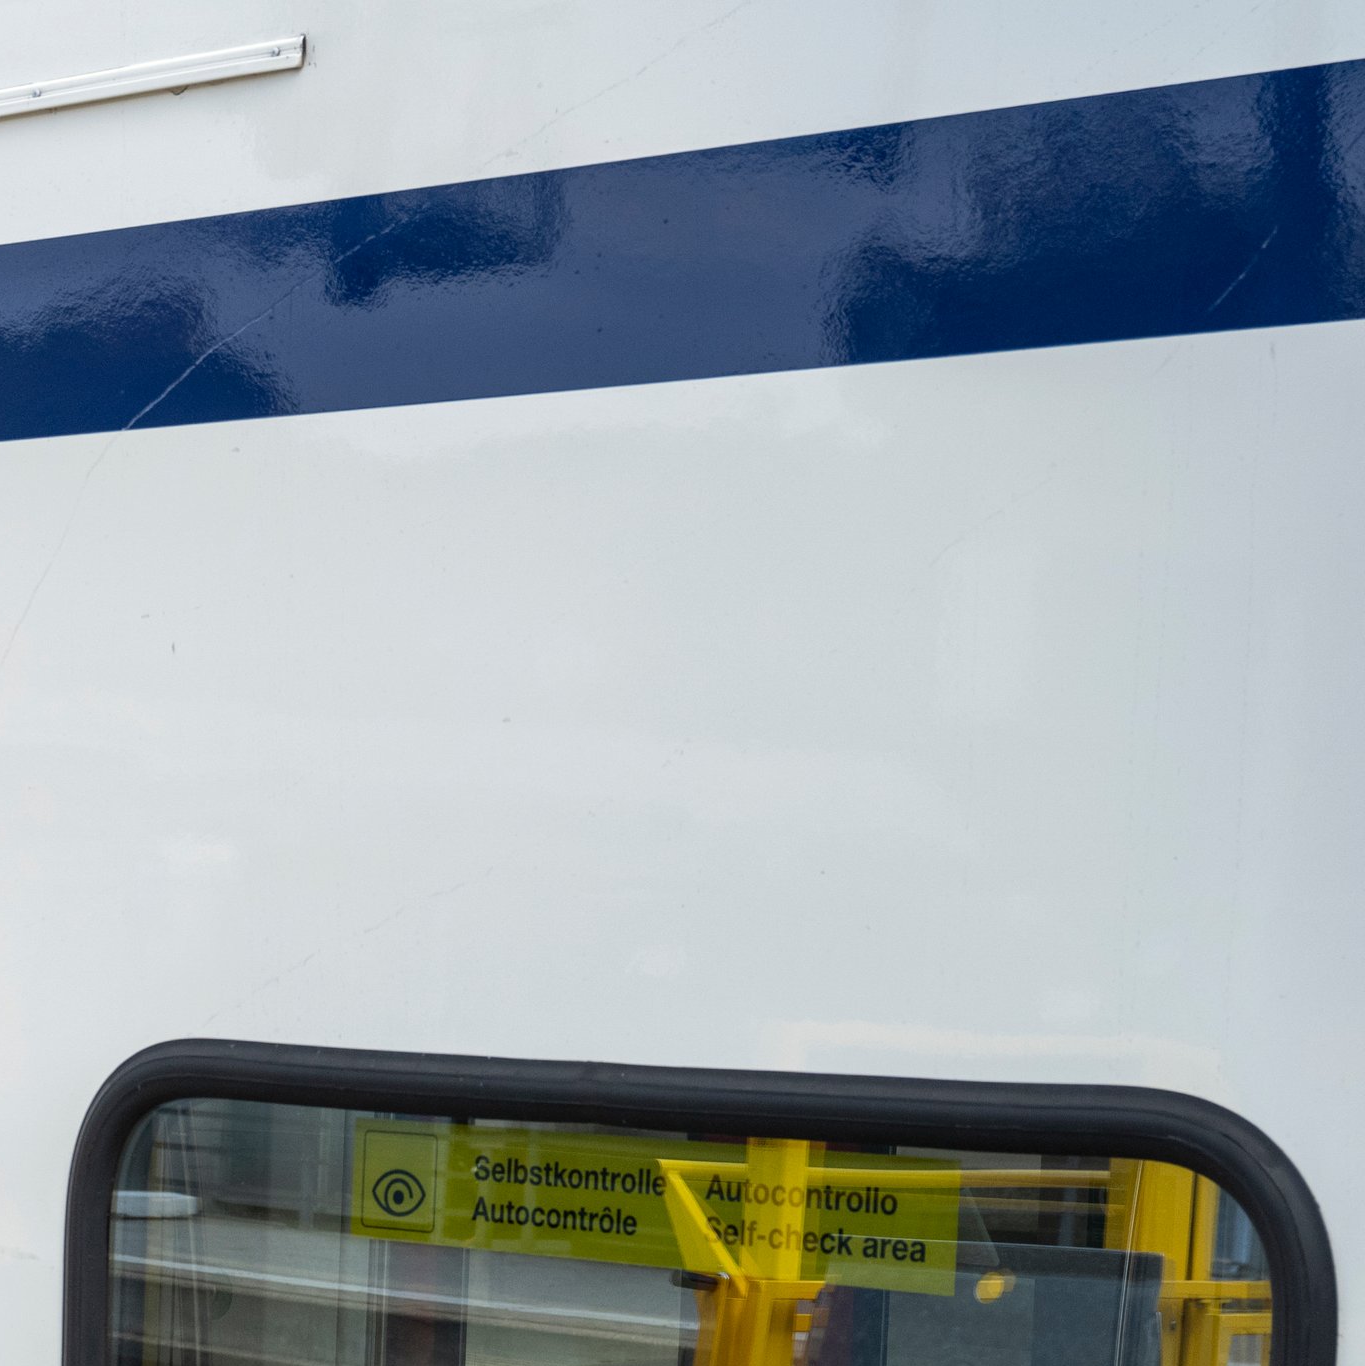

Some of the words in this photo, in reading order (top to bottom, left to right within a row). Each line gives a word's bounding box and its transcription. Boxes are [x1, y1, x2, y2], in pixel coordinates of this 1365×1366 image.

[474, 1155, 667, 1196] Selbstkontrolle
[472, 1196, 638, 1235] Autocontrôle
[863, 1236, 926, 1262] area
